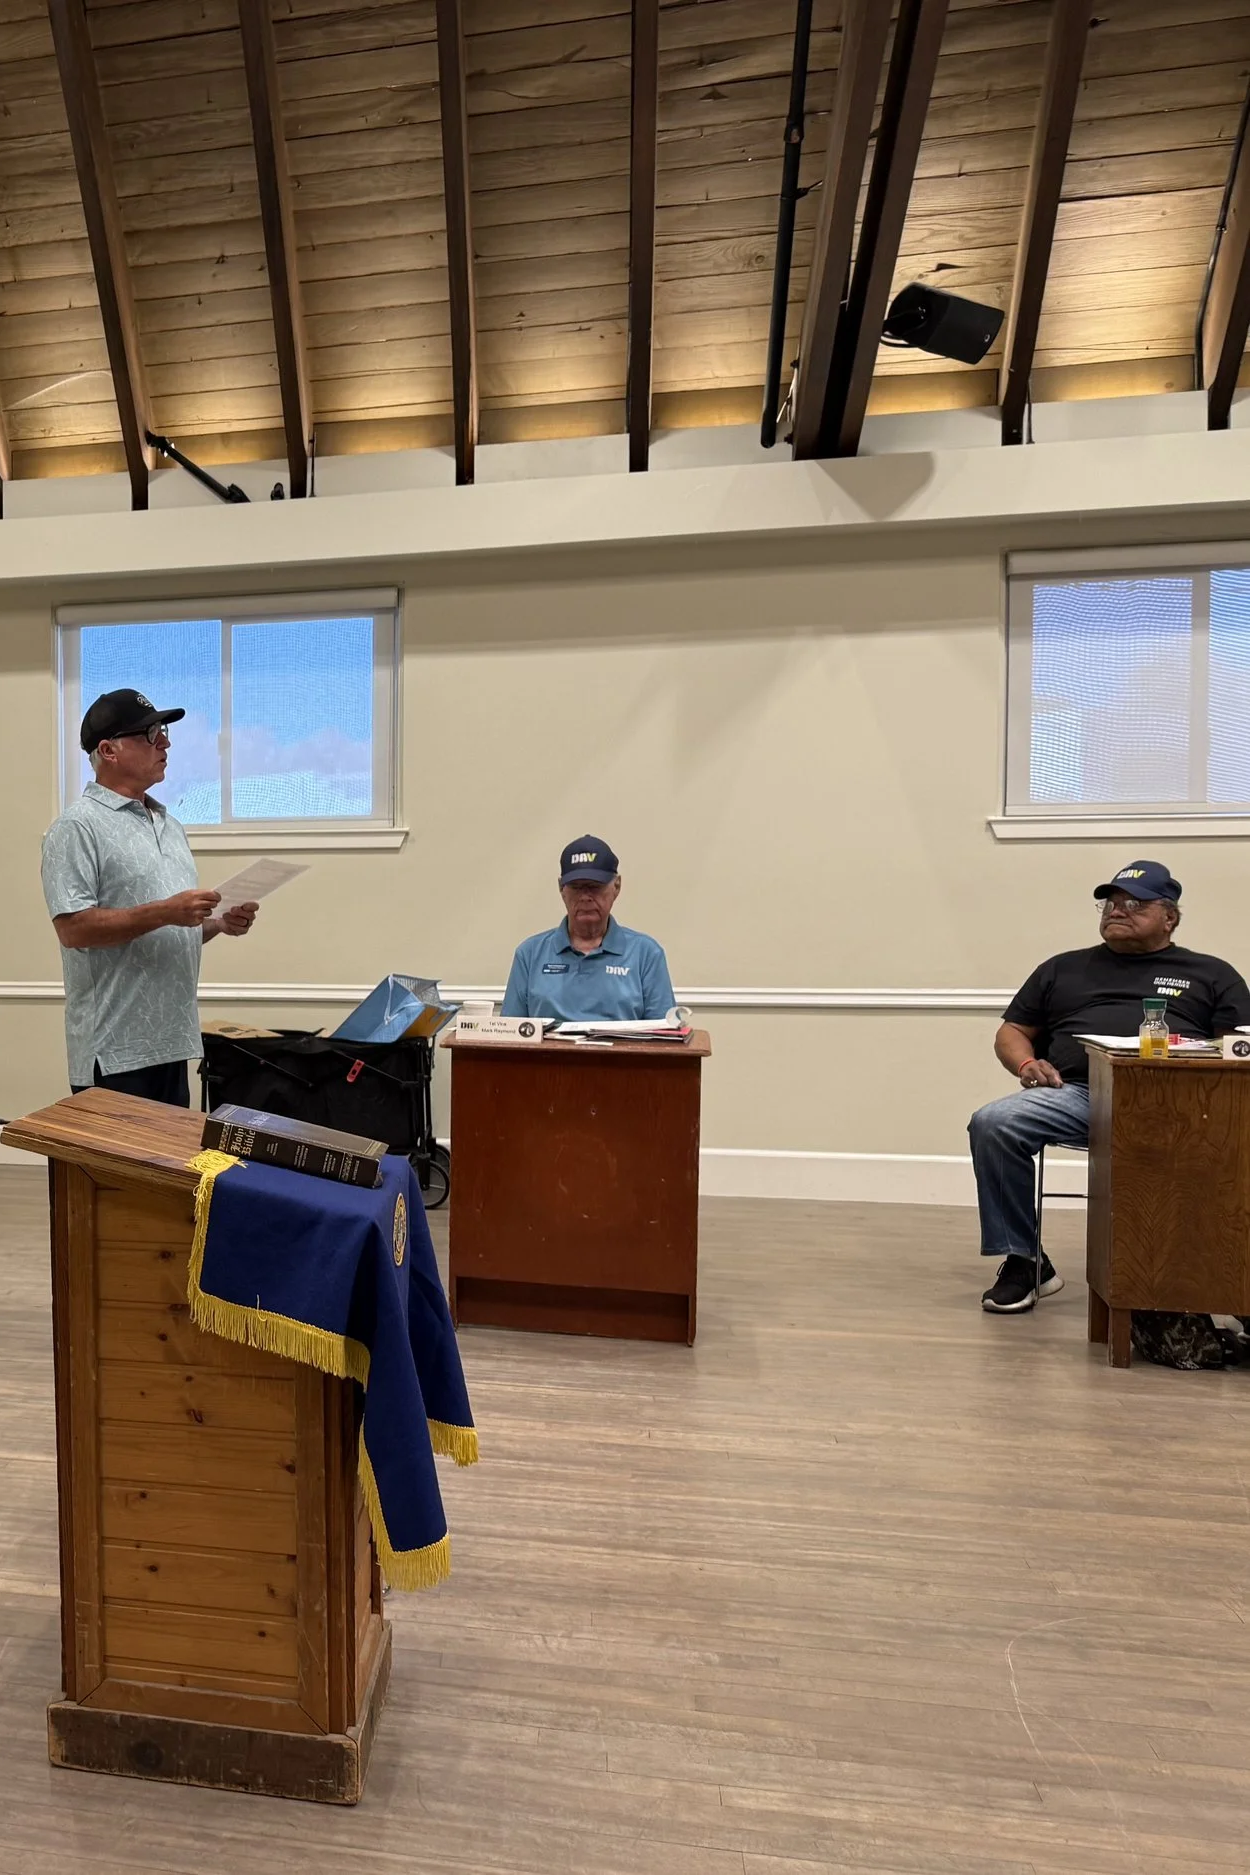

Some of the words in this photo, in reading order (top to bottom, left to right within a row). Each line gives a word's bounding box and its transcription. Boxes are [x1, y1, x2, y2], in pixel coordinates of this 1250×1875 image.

[571, 852, 597, 864] DAV
[1116, 869, 1147, 880] DAV
[605, 965, 630, 976] DAV
[1157, 986, 1183, 997] DAV
[460, 1021, 480, 1029] DAV
[230, 1128, 245, 1153] Holy
[241, 1130, 257, 1157] Bible
